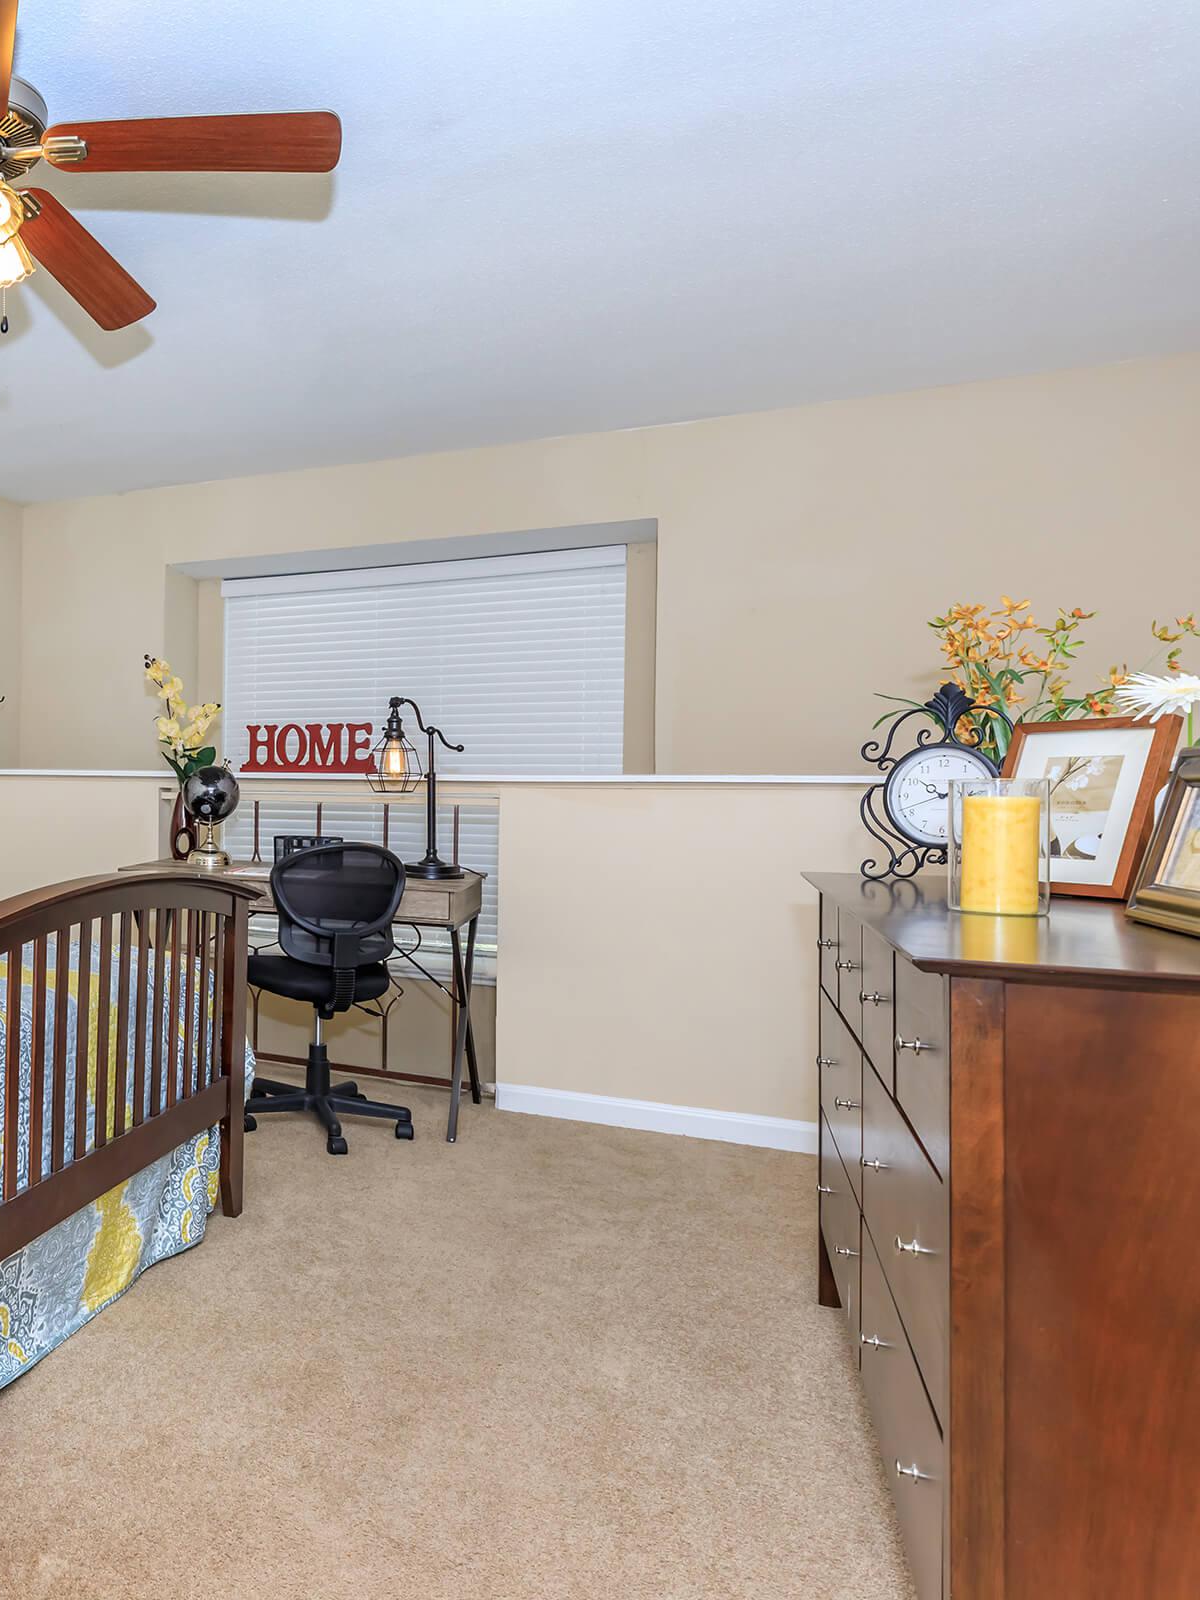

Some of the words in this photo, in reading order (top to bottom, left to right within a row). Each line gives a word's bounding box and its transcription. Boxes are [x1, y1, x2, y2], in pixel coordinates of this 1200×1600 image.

[246, 723, 375, 768] HOME
[939, 759, 950, 767] 12
[920, 765, 930, 774] 11
[963, 764, 967, 773] 1
[907, 778, 919, 786] 10
[903, 793, 909, 801] 9
[908, 808, 915, 817] 8
[921, 820, 928, 828] 7
[939, 825, 945, 834] 6
